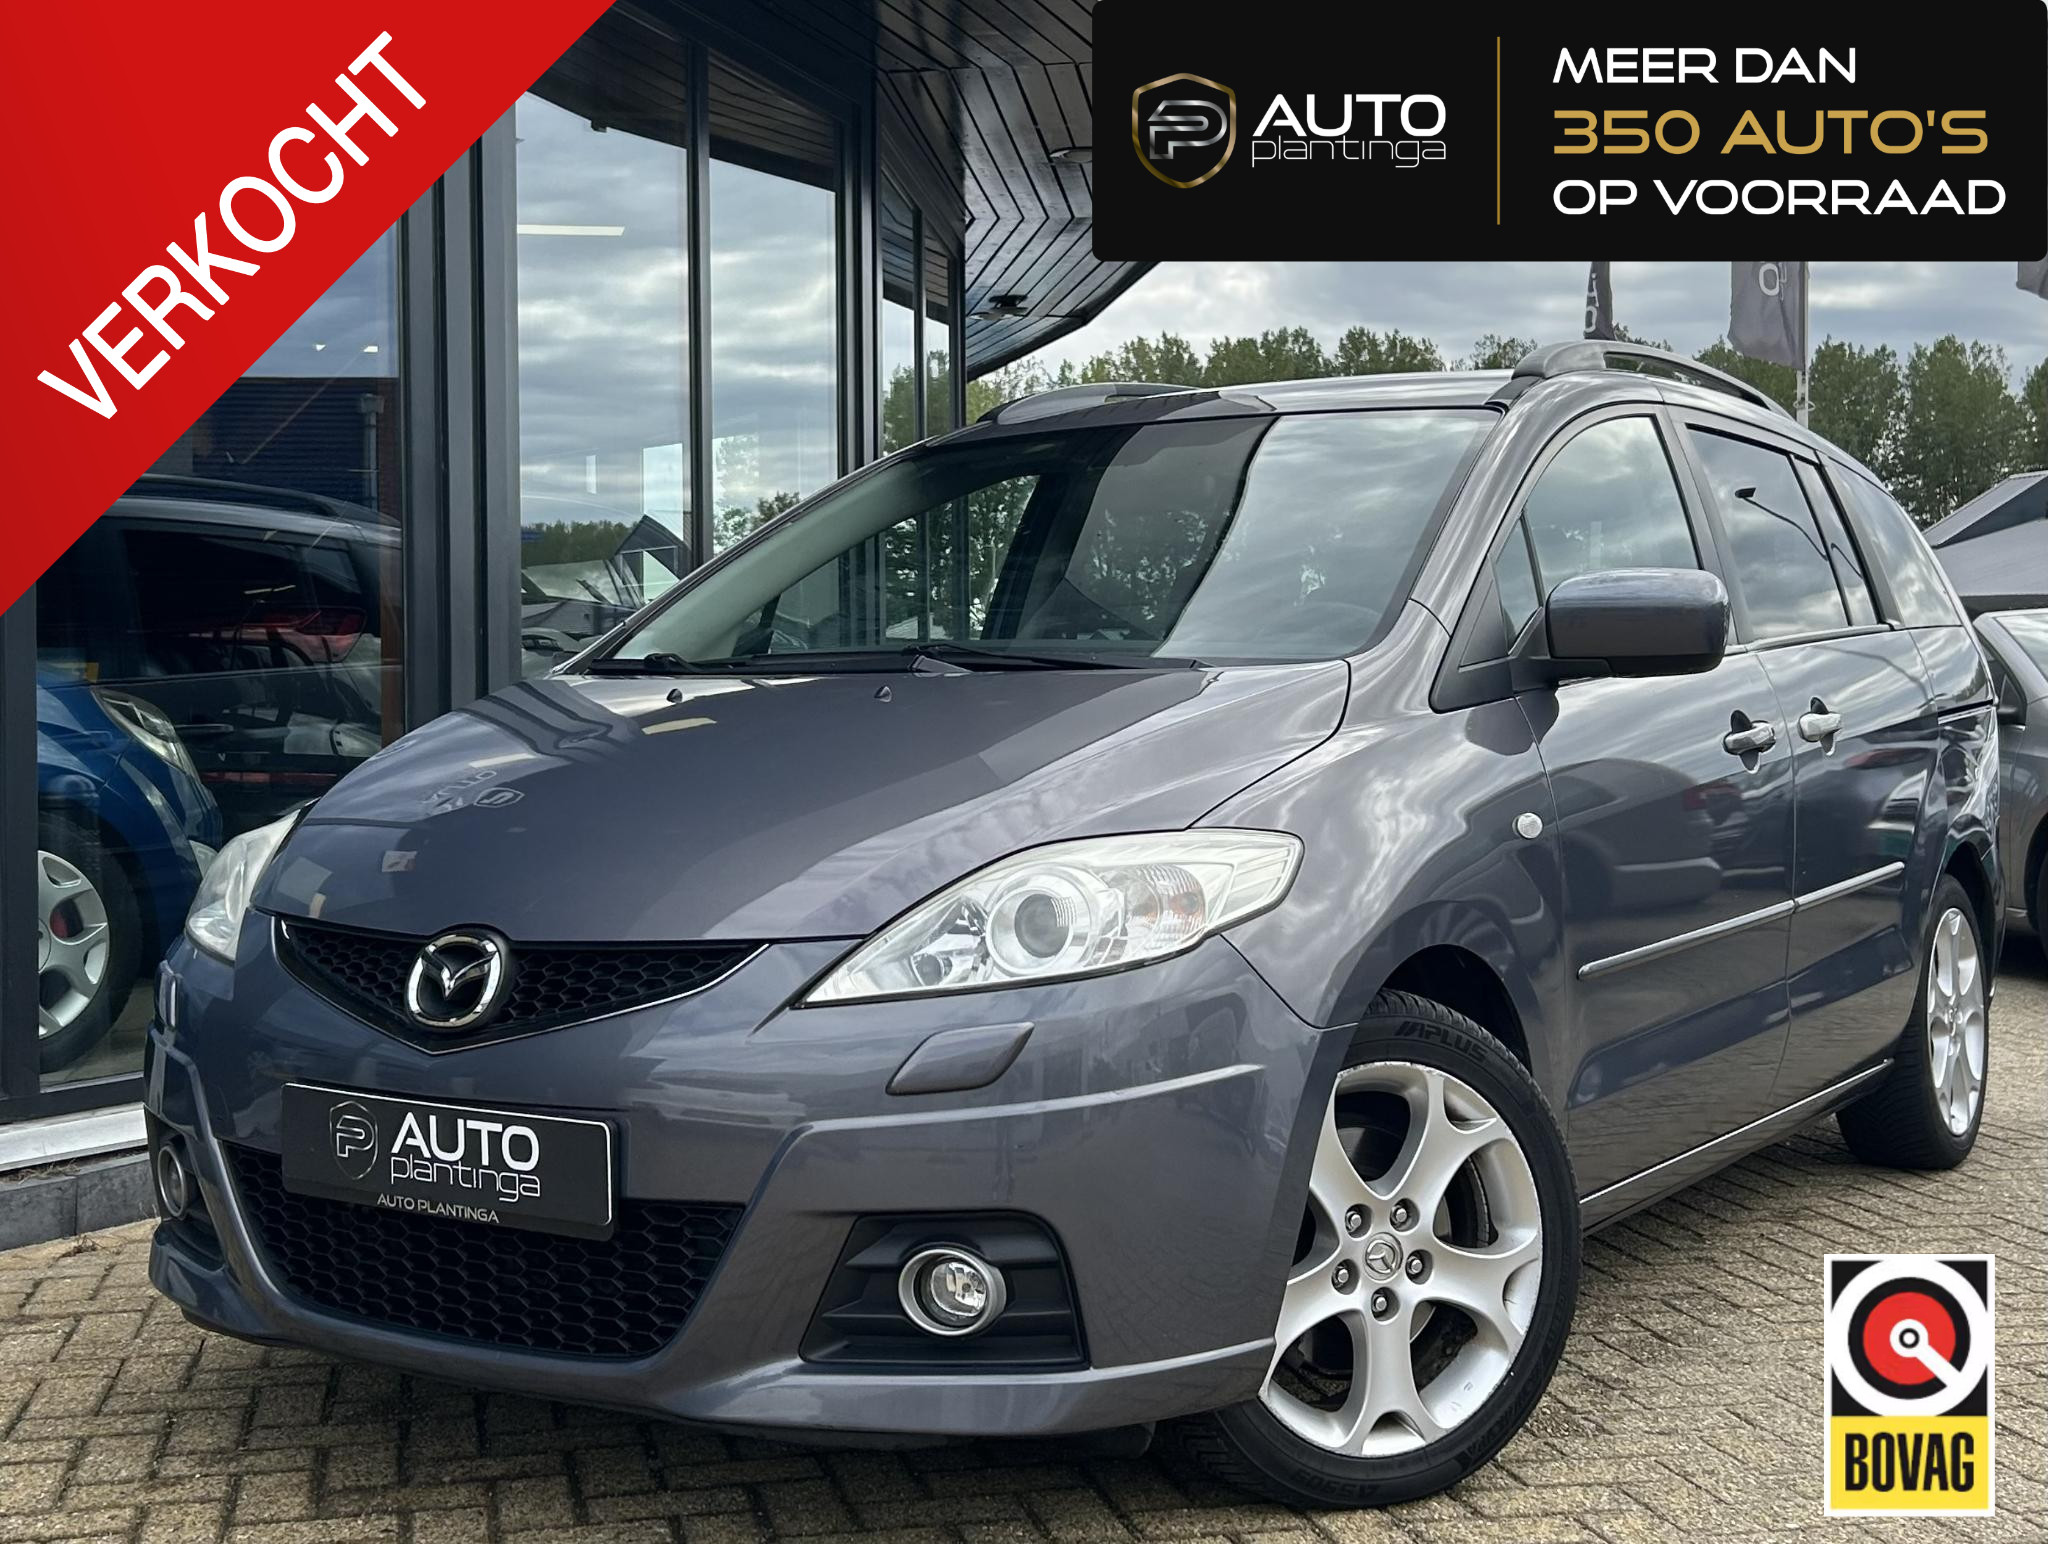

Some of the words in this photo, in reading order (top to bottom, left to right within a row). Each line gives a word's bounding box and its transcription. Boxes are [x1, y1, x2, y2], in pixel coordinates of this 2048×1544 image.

[391, 1112, 540, 1171] AUTO
[391, 1153, 541, 1203] plantinga
[377, 1193, 415, 1210] AUTO
[418, 1199, 500, 1223] PLANTINGA
